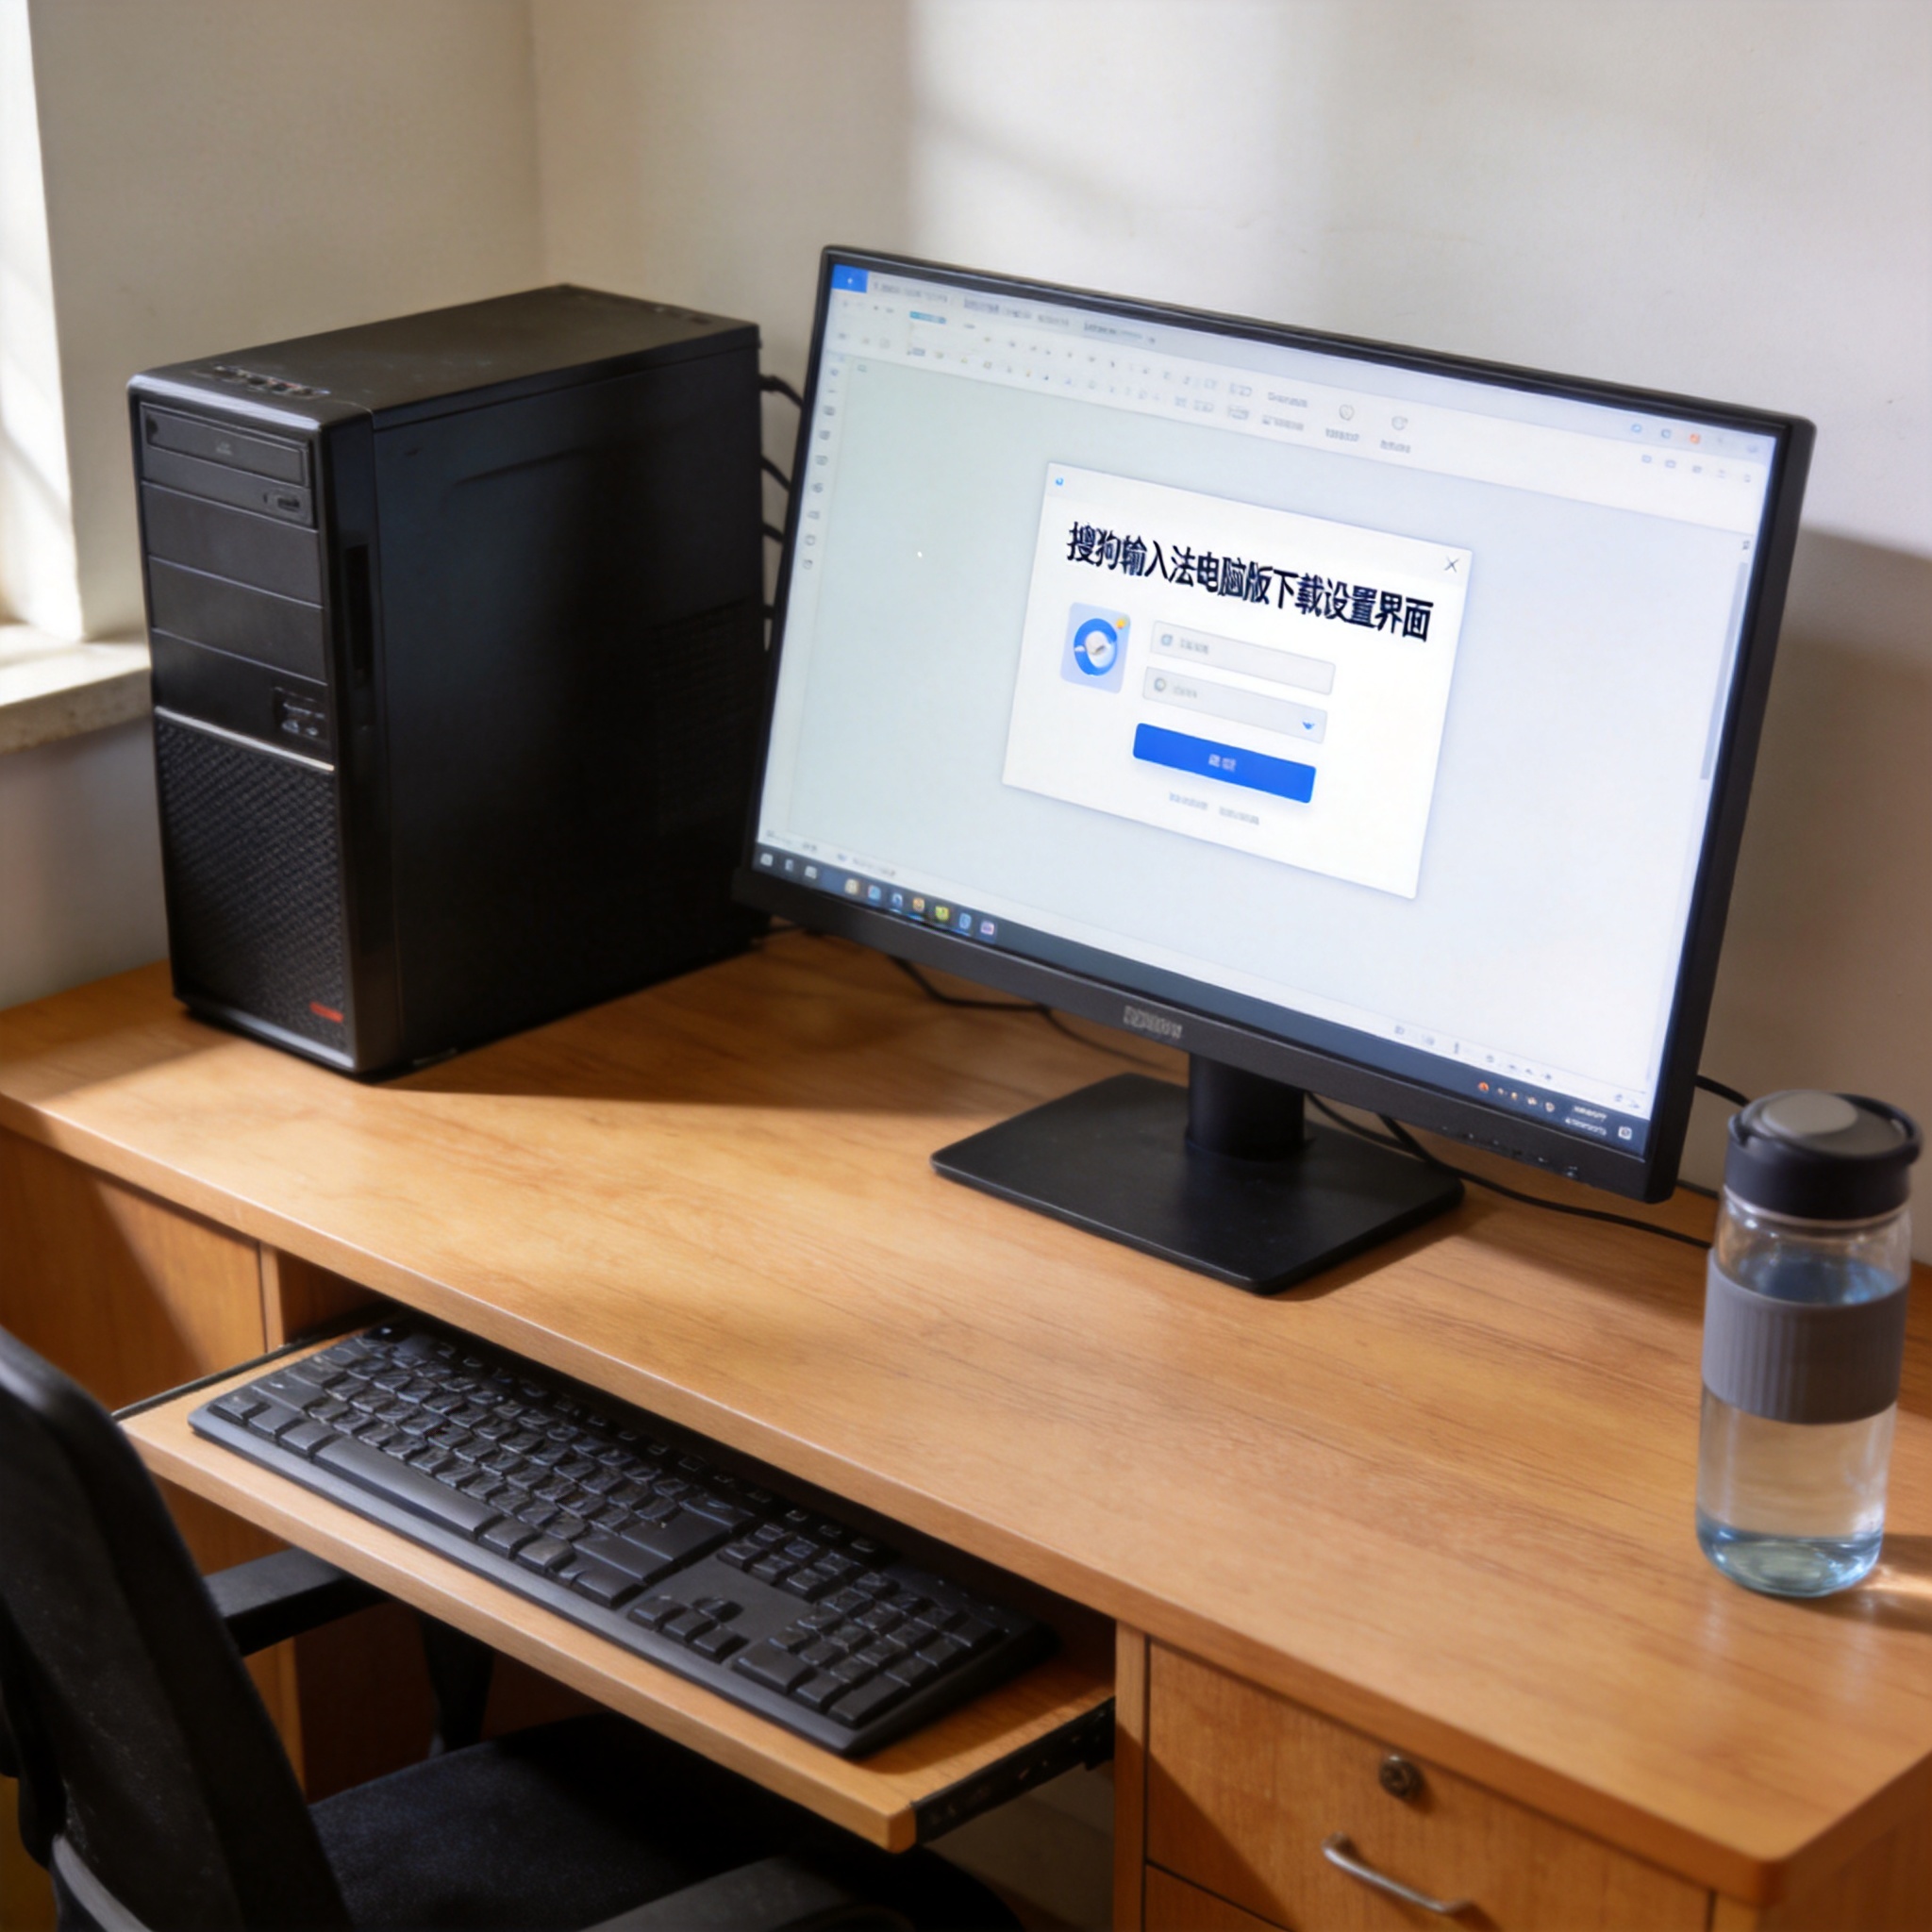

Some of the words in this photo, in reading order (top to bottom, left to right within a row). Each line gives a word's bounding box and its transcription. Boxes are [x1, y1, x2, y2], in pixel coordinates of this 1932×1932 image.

[1067, 522, 1434, 641] 搜狗输入法电脑版下载设置界面
